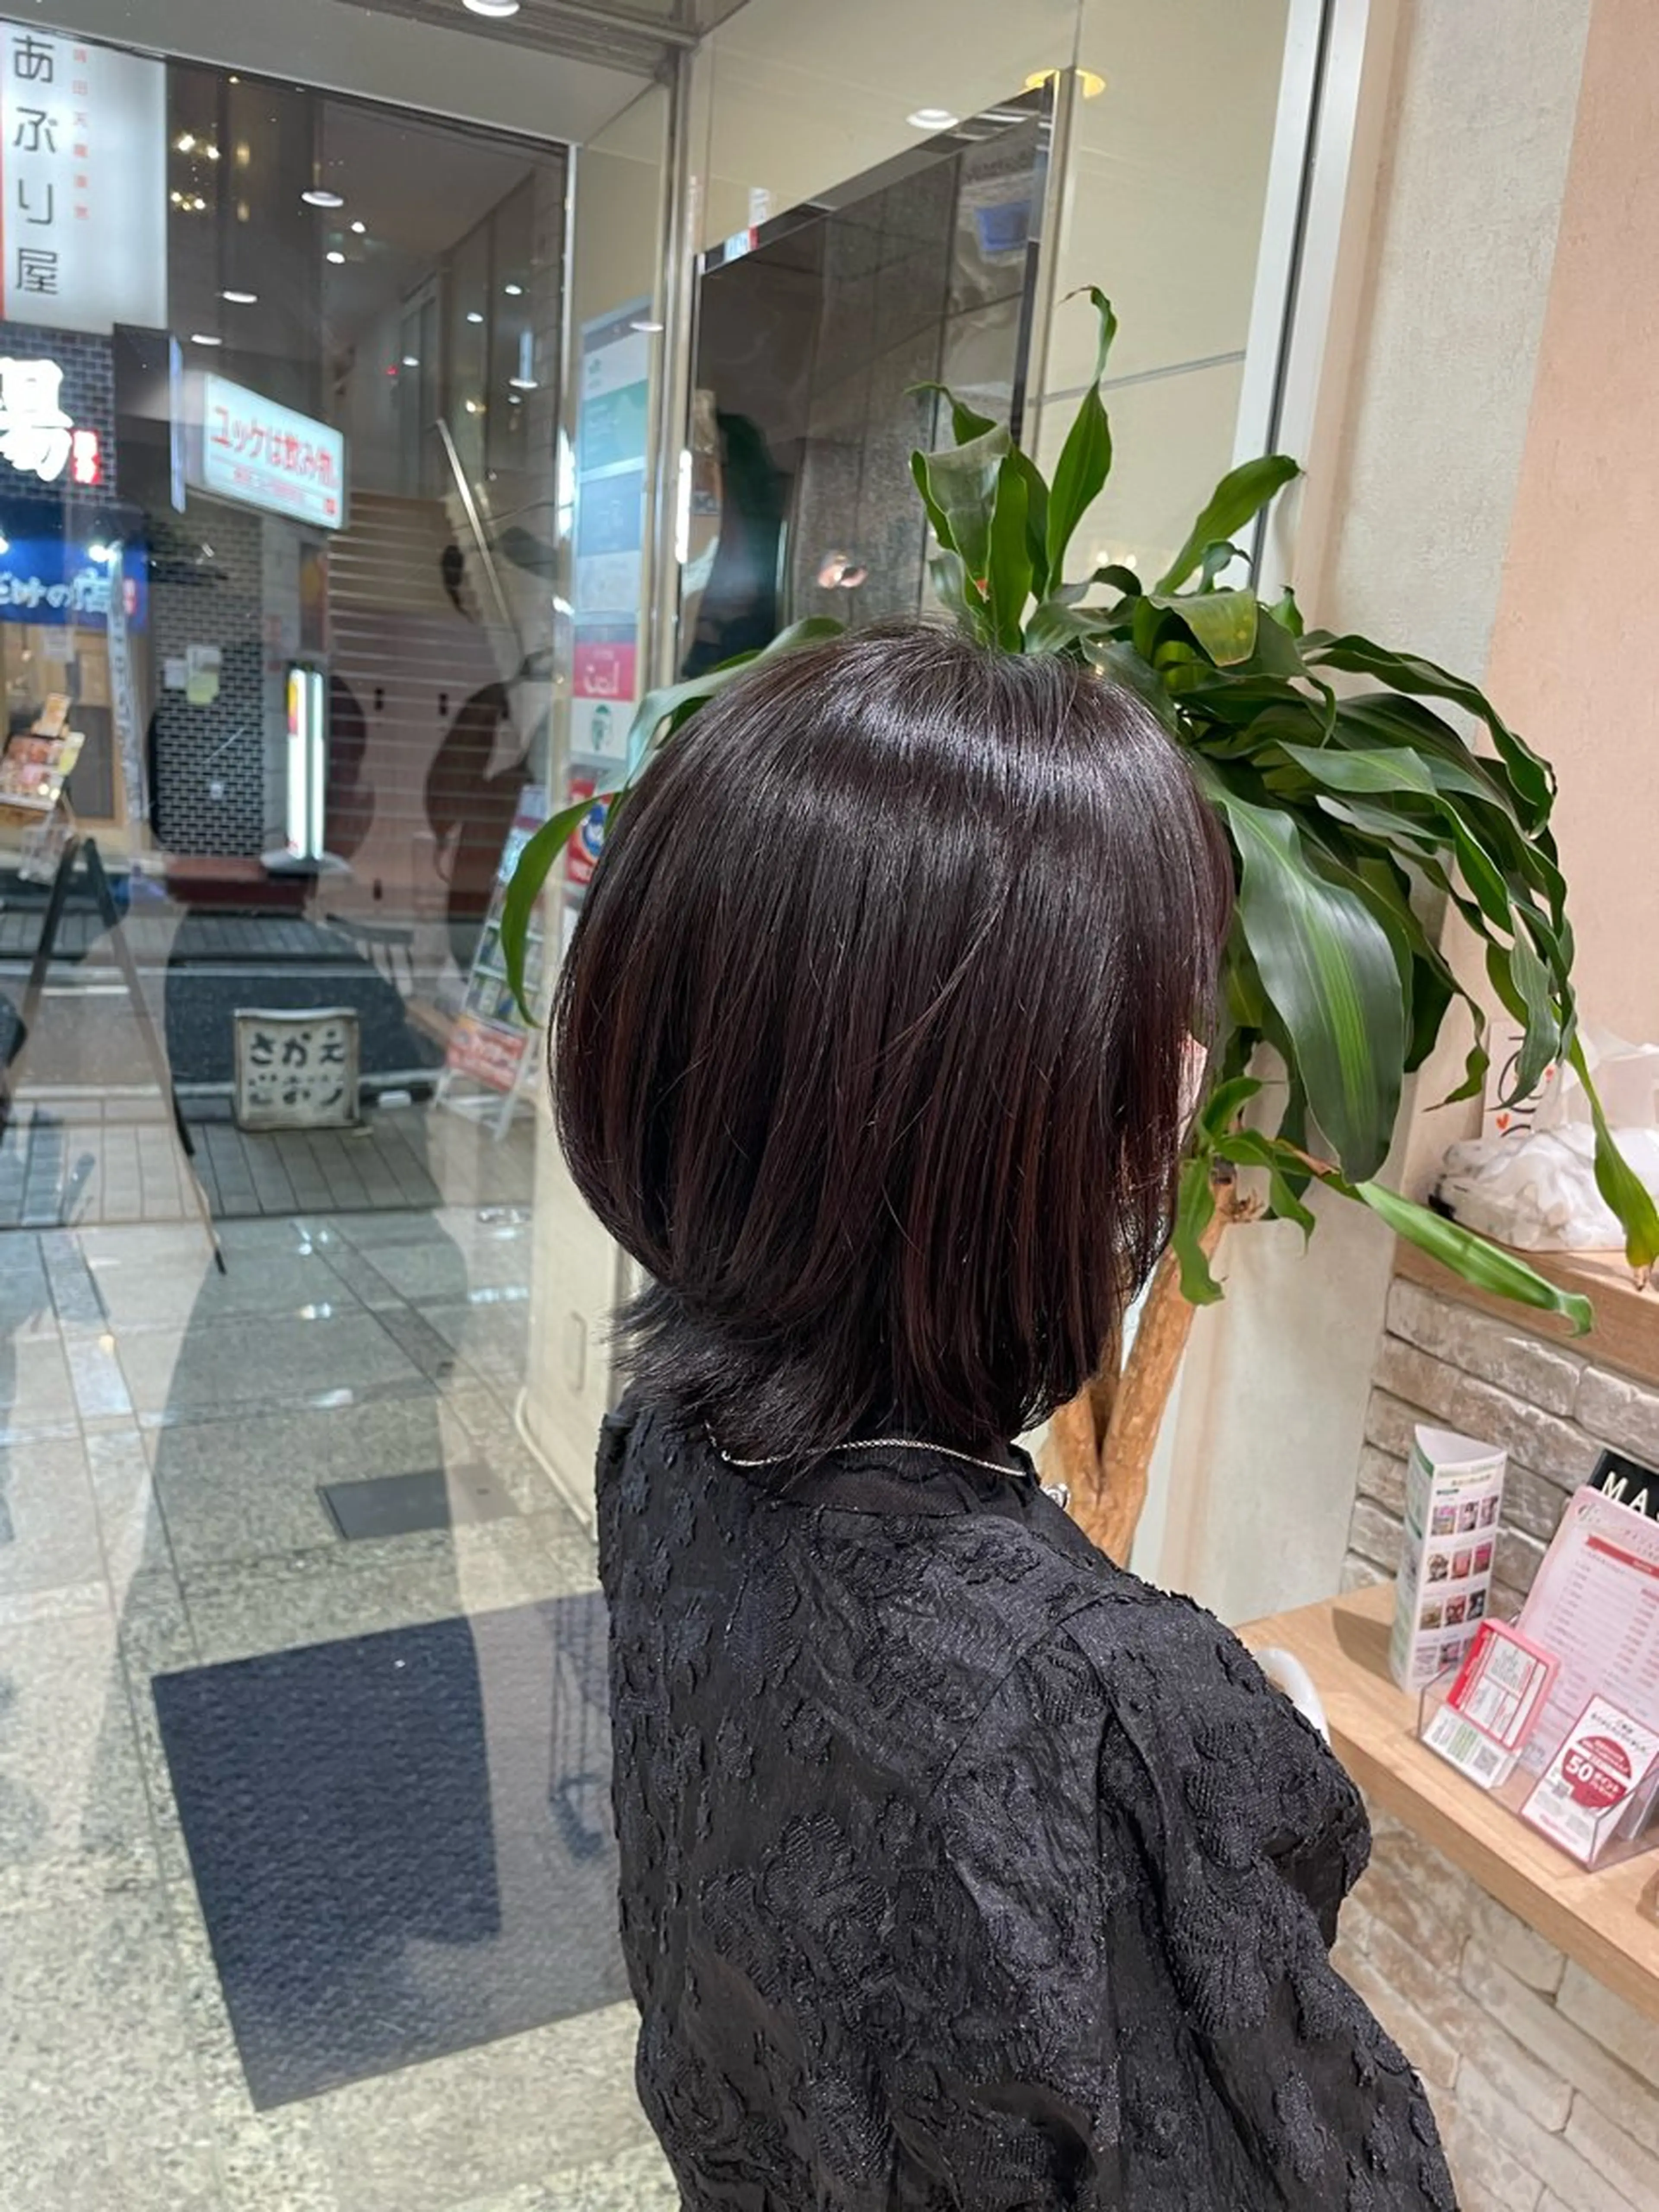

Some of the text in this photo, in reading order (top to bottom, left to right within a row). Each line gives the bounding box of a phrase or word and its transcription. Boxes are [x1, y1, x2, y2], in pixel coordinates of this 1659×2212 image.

[12, 35, 58, 296] あぶり屋
[250, 1030, 344, 1067] さかえ
[1600, 1471, 1659, 1524] MA
[1565, 1754, 1594, 1783] 50
